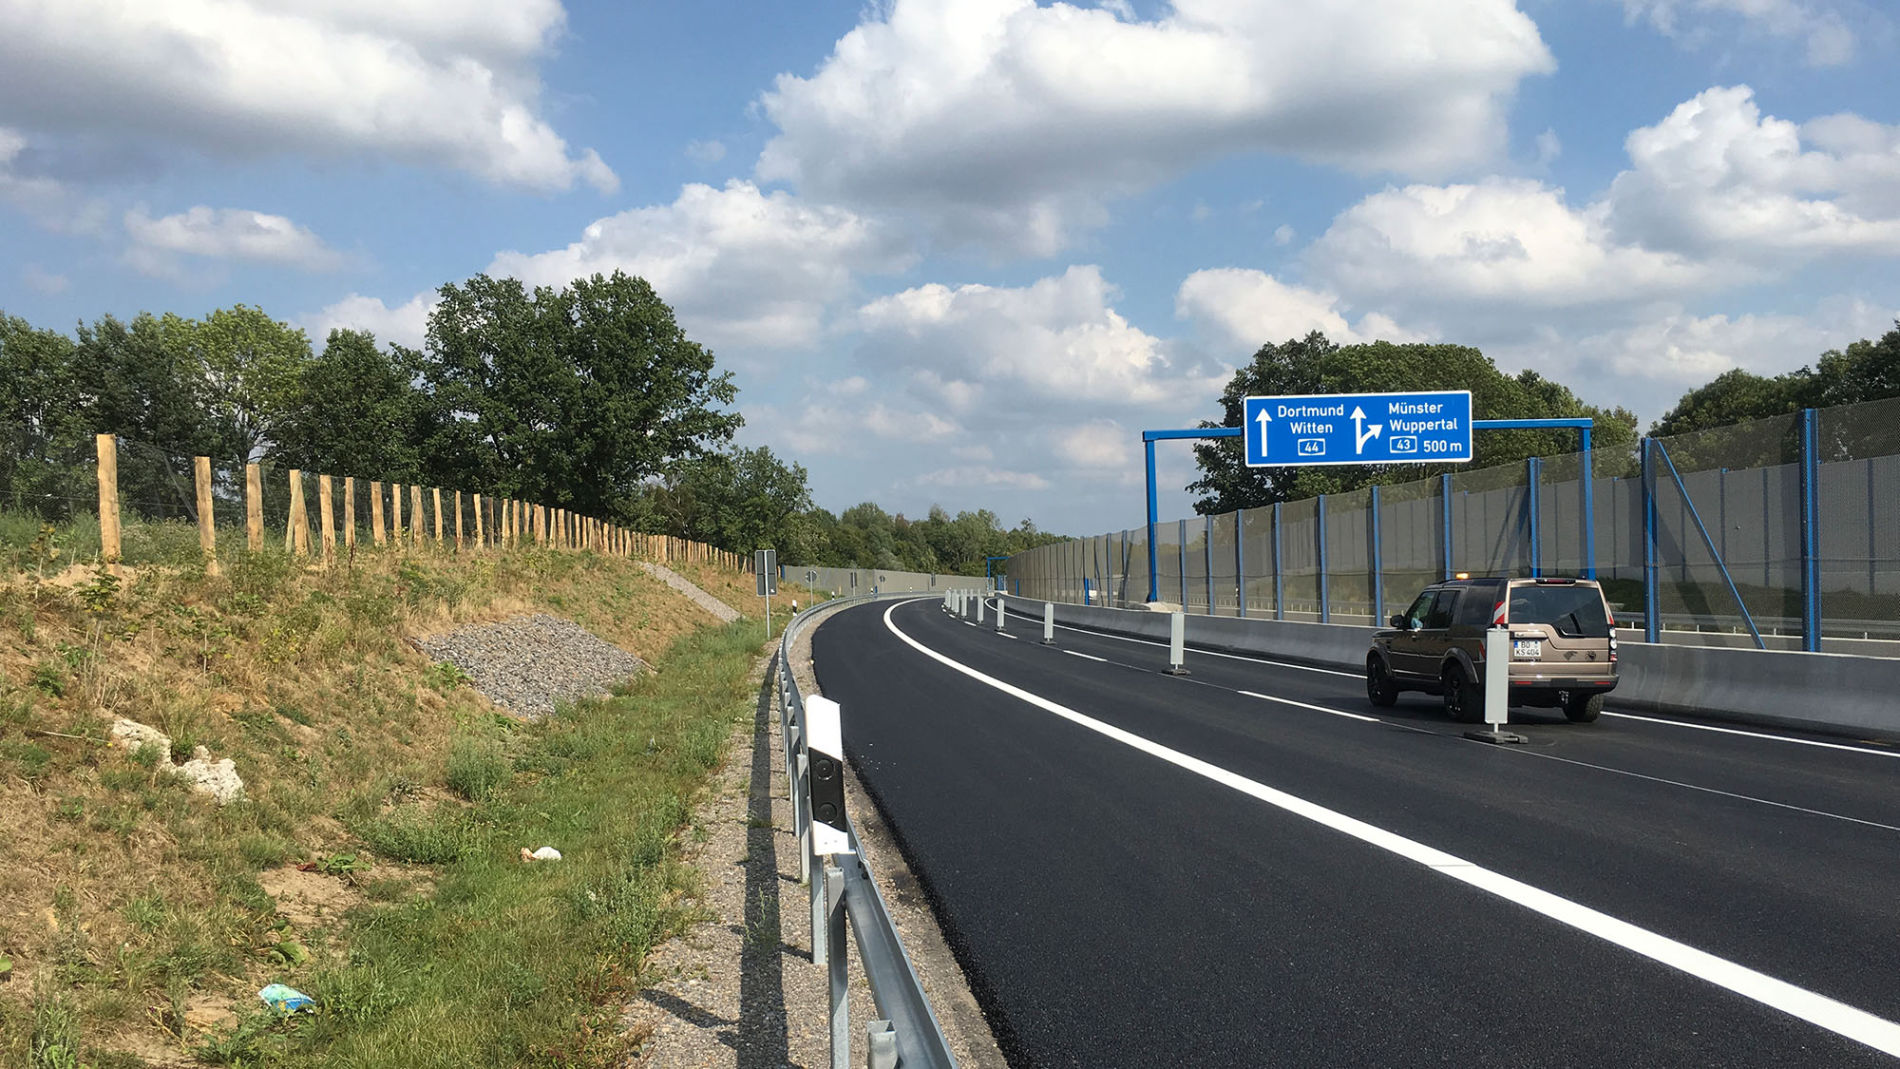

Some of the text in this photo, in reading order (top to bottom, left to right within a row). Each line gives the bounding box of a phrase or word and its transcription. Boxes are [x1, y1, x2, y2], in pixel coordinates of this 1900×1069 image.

[1277, 404, 1344, 418] Dortmund
[1388, 402, 1444, 415] Münster
[1290, 422, 1334, 434] Witten
[1389, 418, 1458, 433] Wuppertal
[1304, 441, 1319, 452] 44
[1396, 438, 1462, 452] 43 500 m
